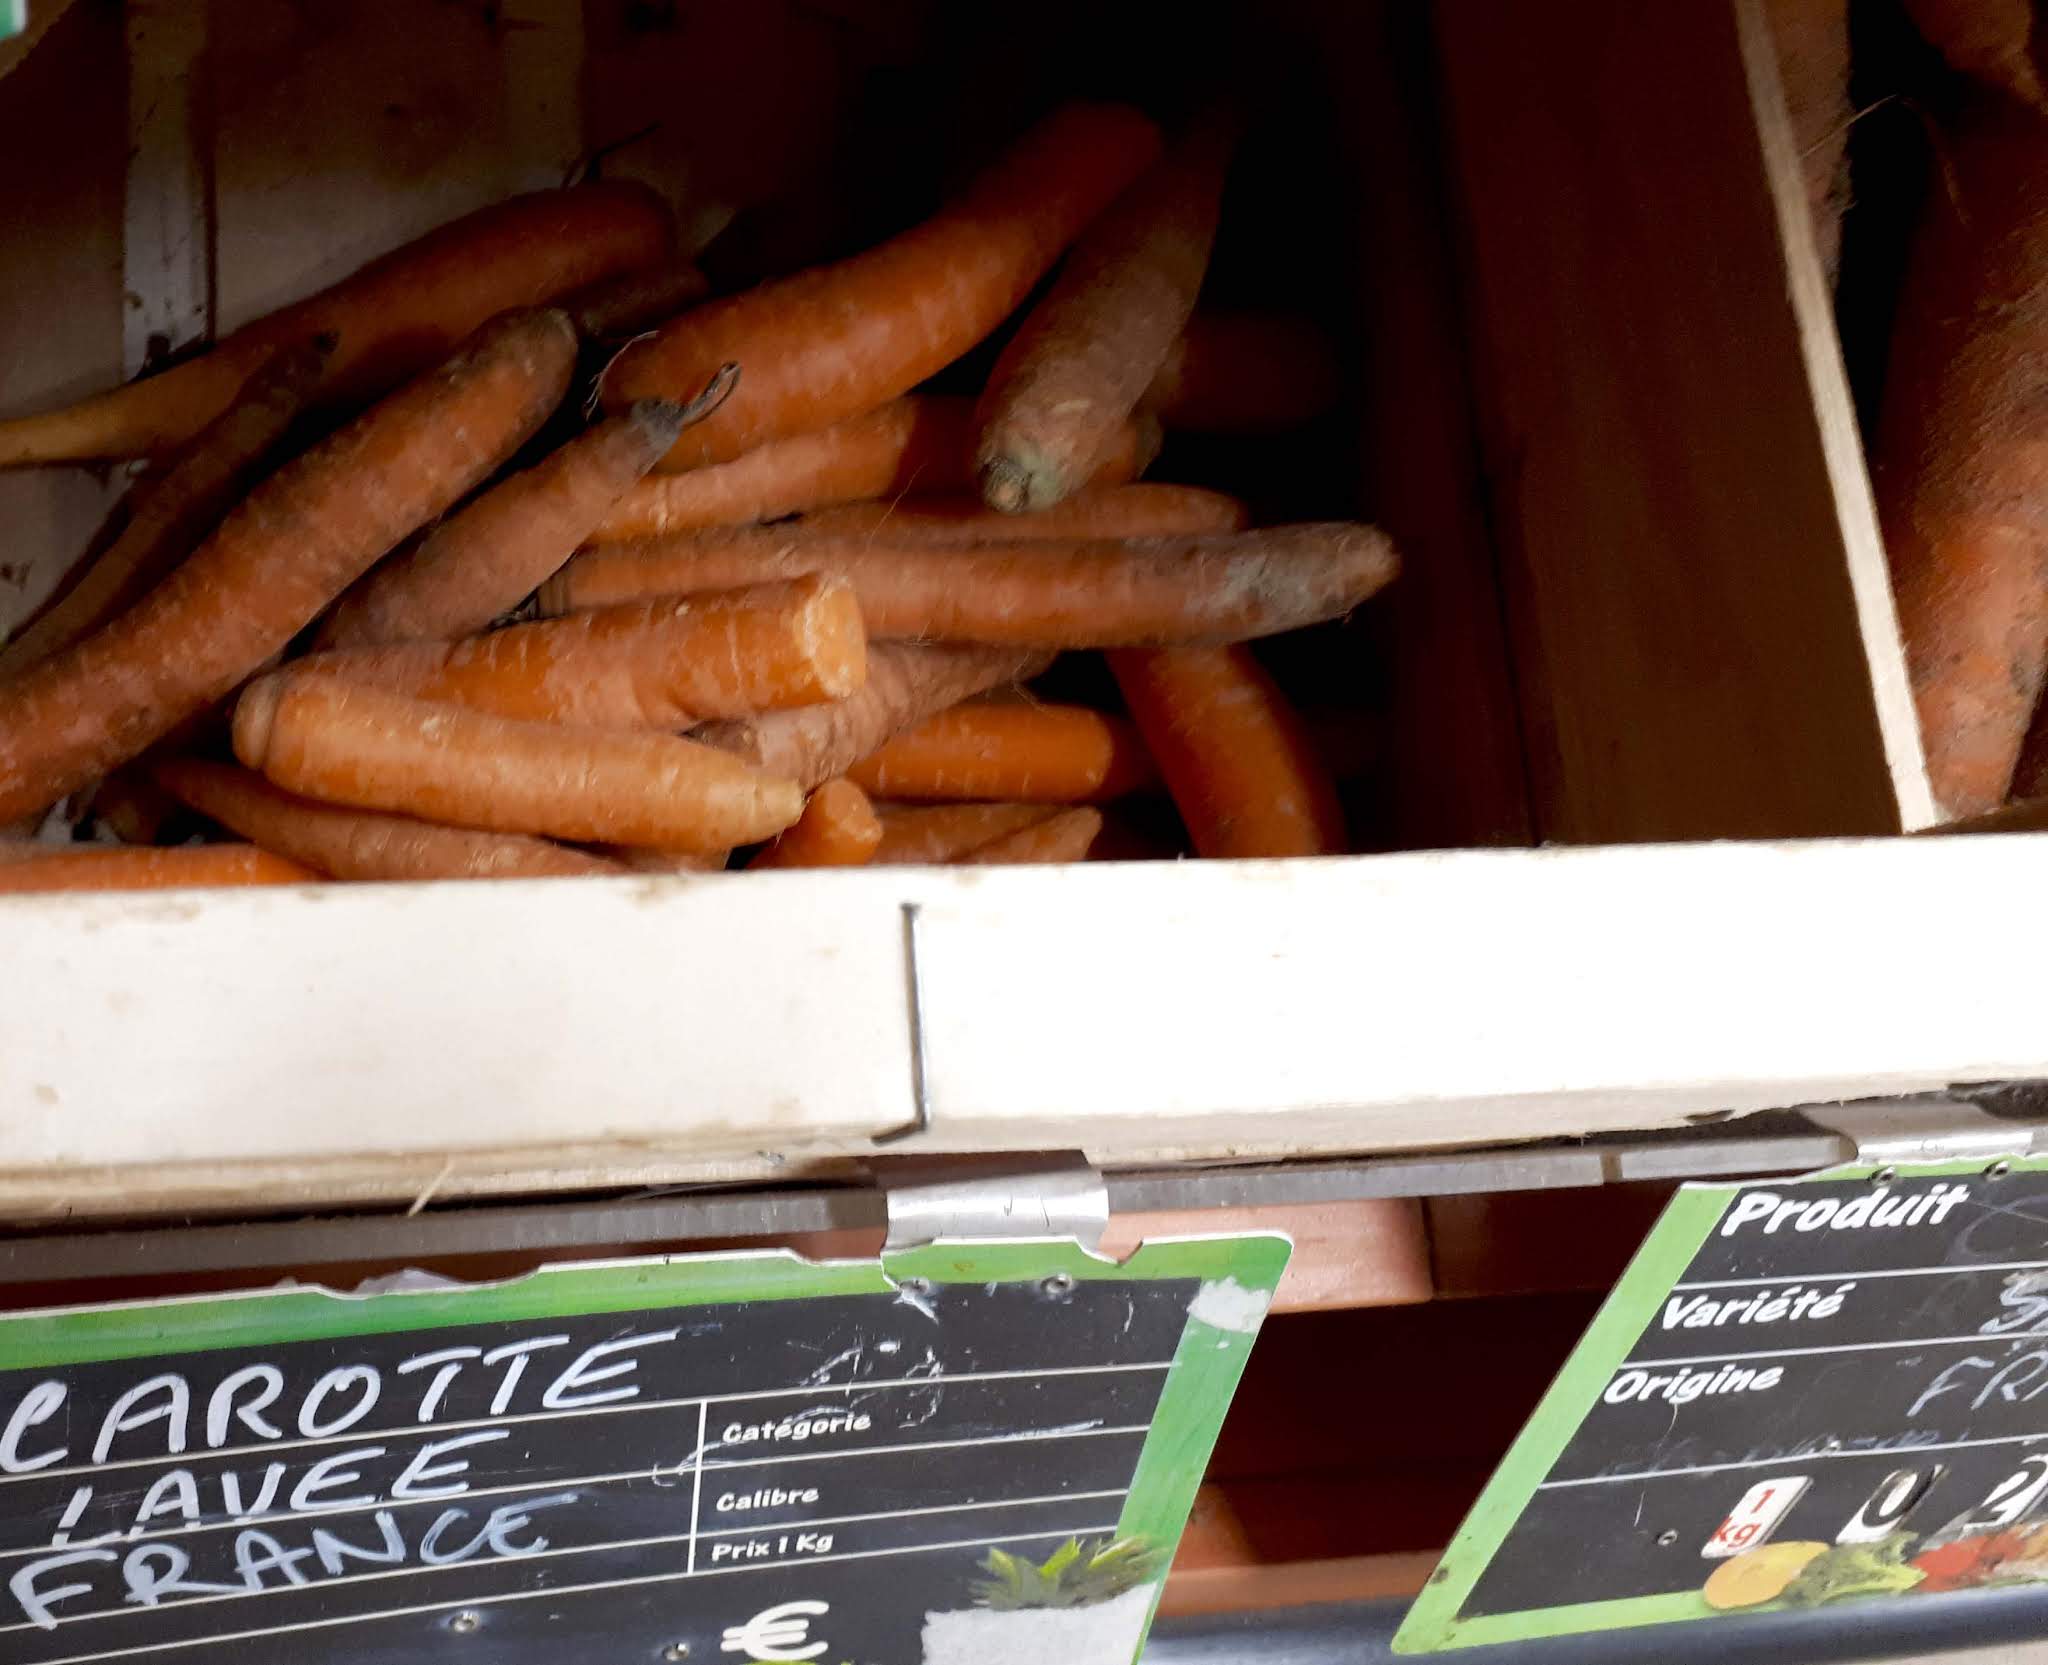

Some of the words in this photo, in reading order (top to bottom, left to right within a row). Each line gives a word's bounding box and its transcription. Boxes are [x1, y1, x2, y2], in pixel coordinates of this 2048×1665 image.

[1721, 1184, 1970, 1236] Produit
[1661, 1281, 1857, 1330] Variété
[0, 1328, 679, 1473] CAROTTE
[1604, 1362, 1784, 1405] Origine
[722, 1411, 872, 1443] Catégorie
[51, 1429, 510, 1549] LAVEE
[716, 1487, 820, 1512] Calibre
[1750, 1488, 1776, 1513] 1
[711, 1539, 770, 1562] Prix
[795, 1532, 834, 1553] Kg
[1708, 1515, 1761, 1547] kg
[10, 1494, 578, 1630] FRANCE
[720, 1599, 830, 1661] €
